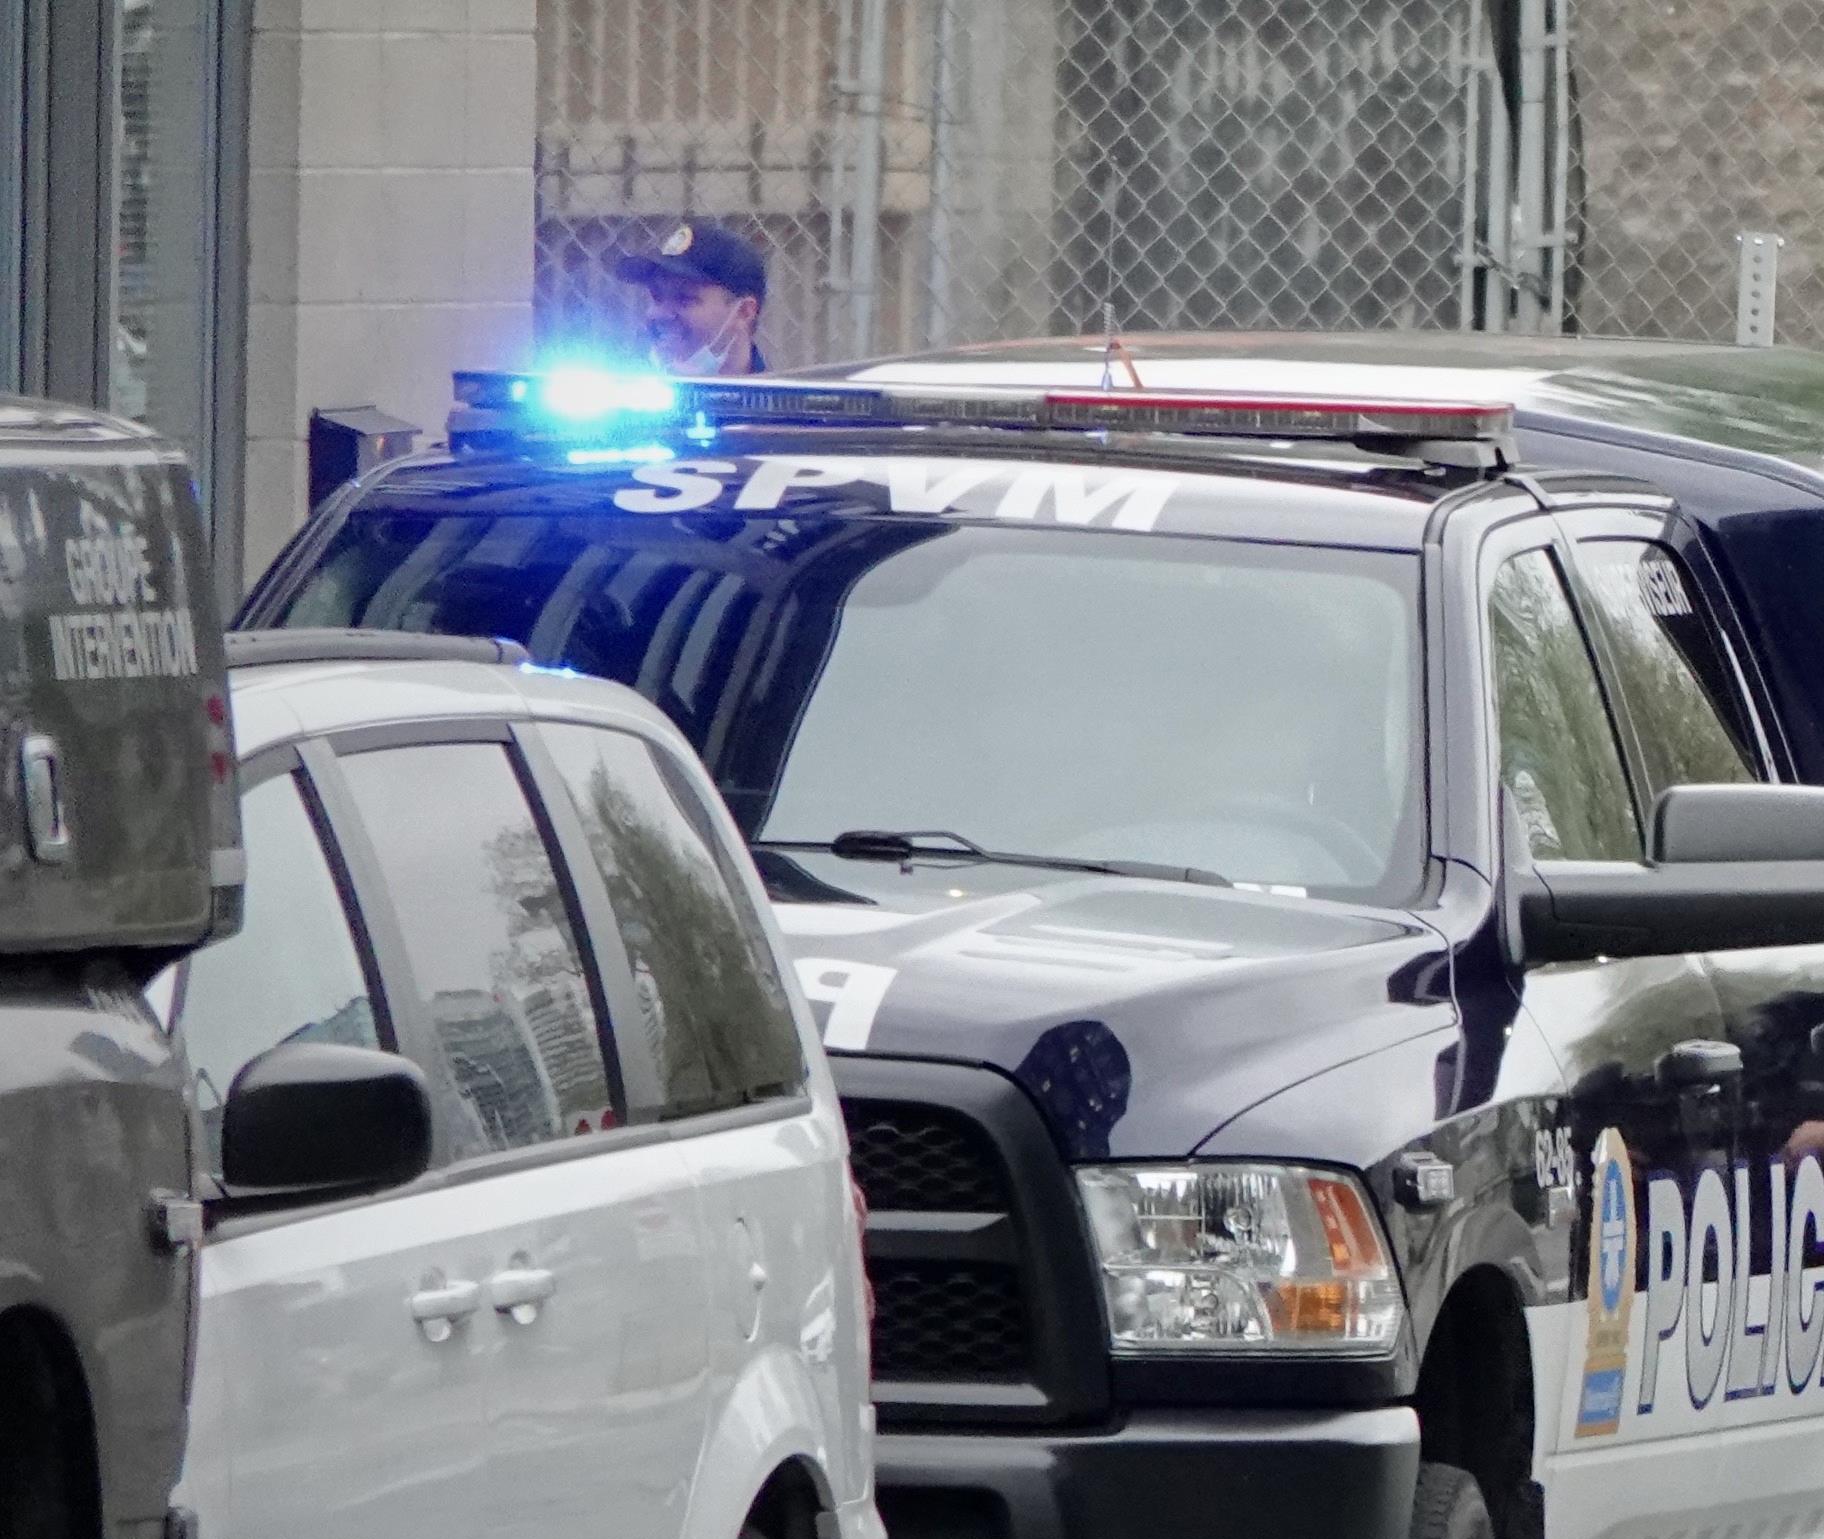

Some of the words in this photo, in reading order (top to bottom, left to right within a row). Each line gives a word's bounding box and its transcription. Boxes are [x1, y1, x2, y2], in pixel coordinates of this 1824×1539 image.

[612, 455, 1181, 532] SPVM
[65, 536, 157, 606] GROUPE
[49, 608, 200, 681] INTERVENTION
